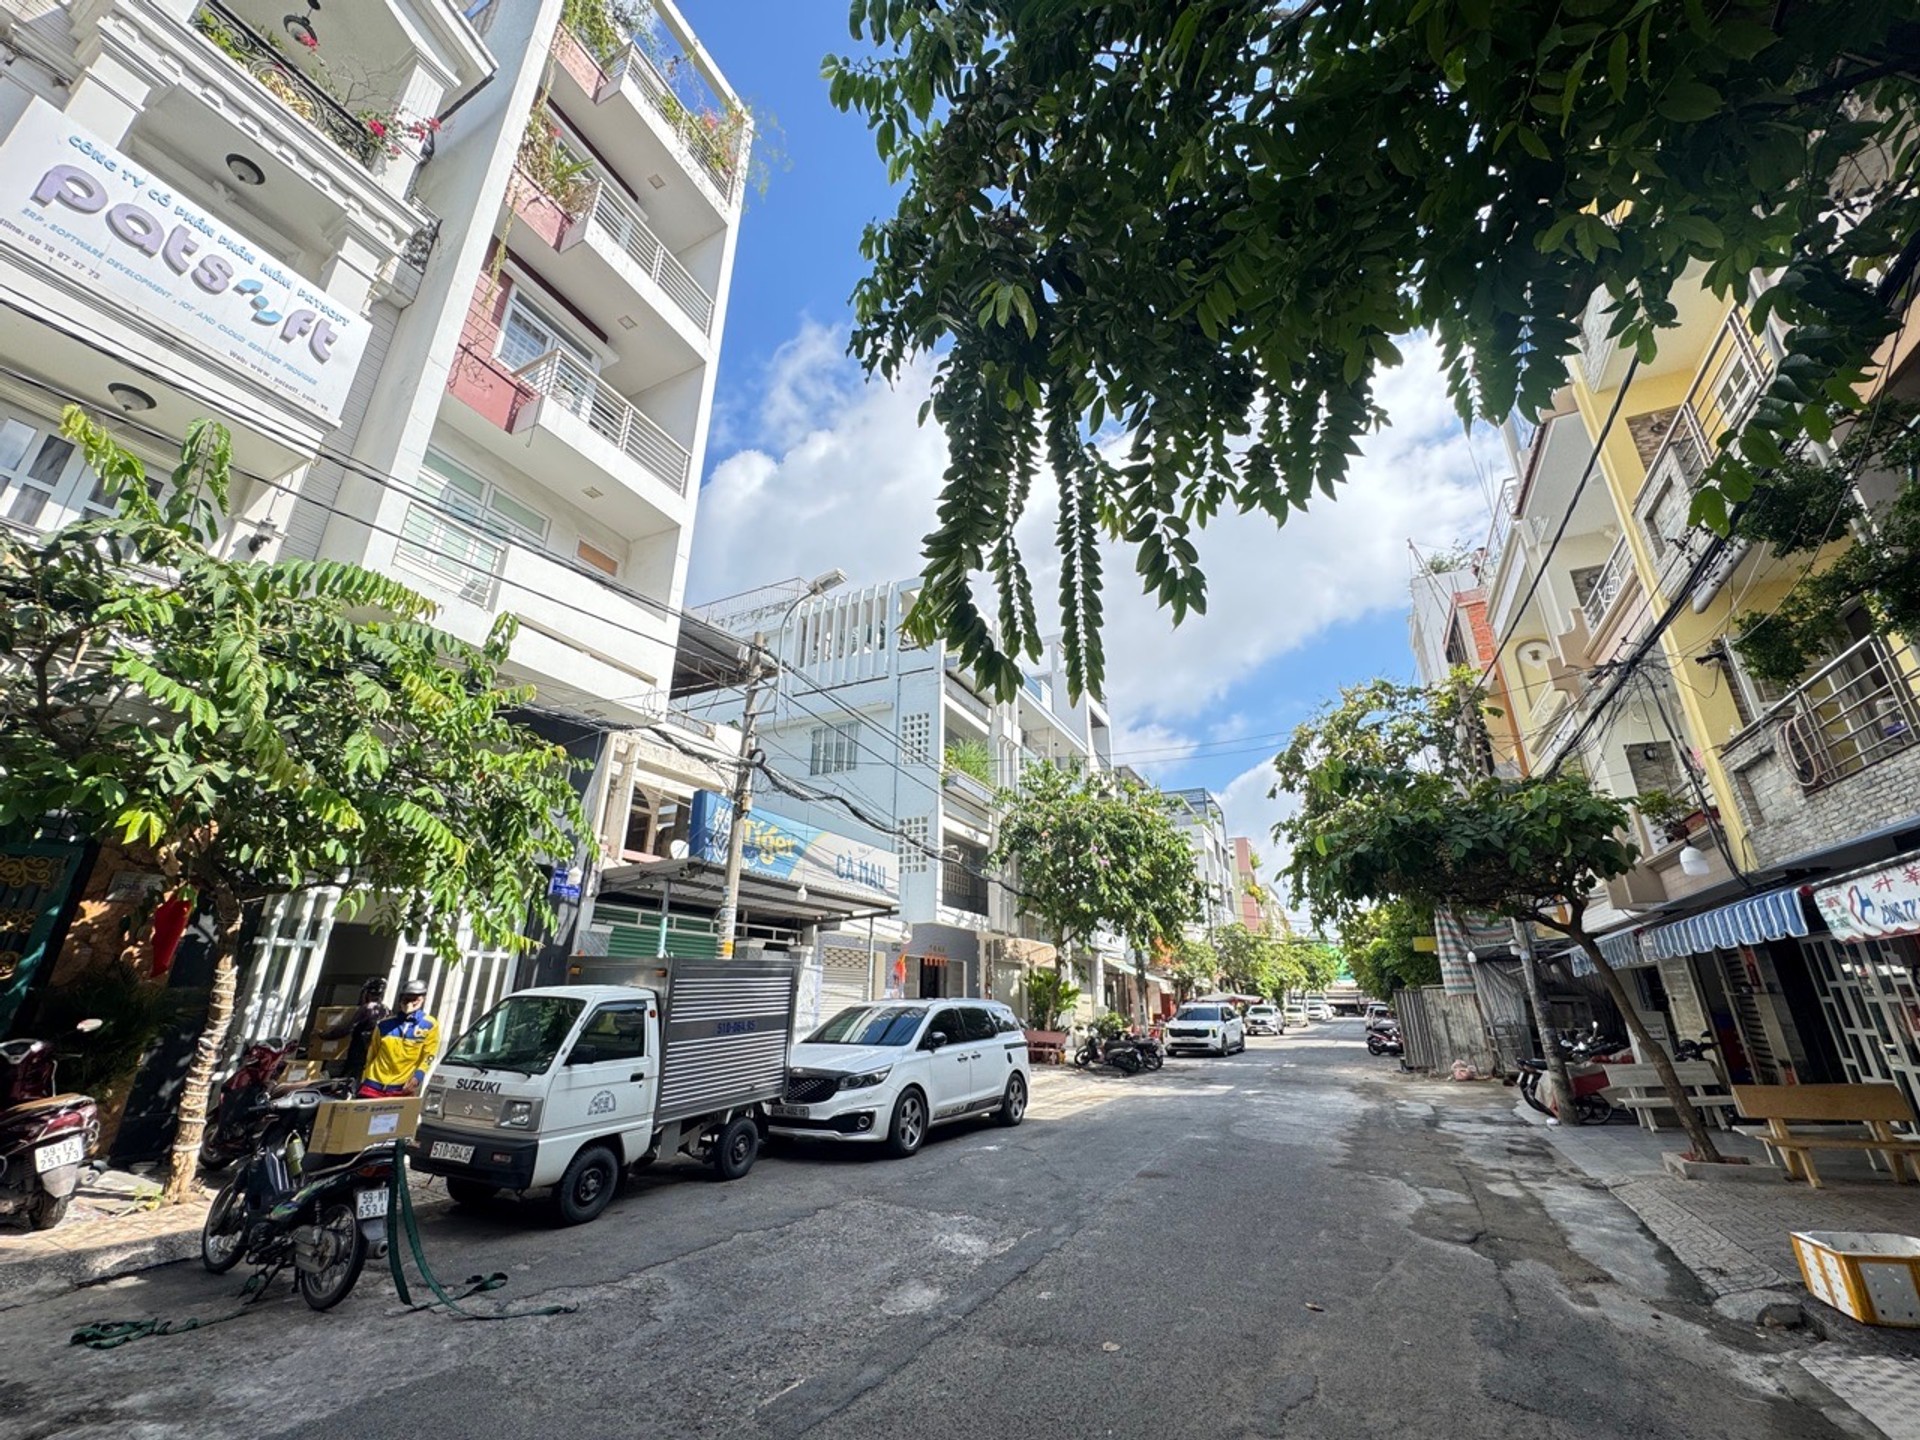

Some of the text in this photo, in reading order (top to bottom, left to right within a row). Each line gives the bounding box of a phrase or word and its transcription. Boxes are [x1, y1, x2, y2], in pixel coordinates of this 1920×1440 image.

[69, 136, 117, 173] CÔNG
[122, 169, 145, 188] TY
[49, 223, 104, 260] SOFTWARE
[196, 311, 216, 326] AND
[217, 323, 246, 344] CLOUD
[743, 818, 797, 866] Tiger
[836, 849, 886, 889] CÀ MAU
[456, 1078, 502, 1094] SUZUKI
